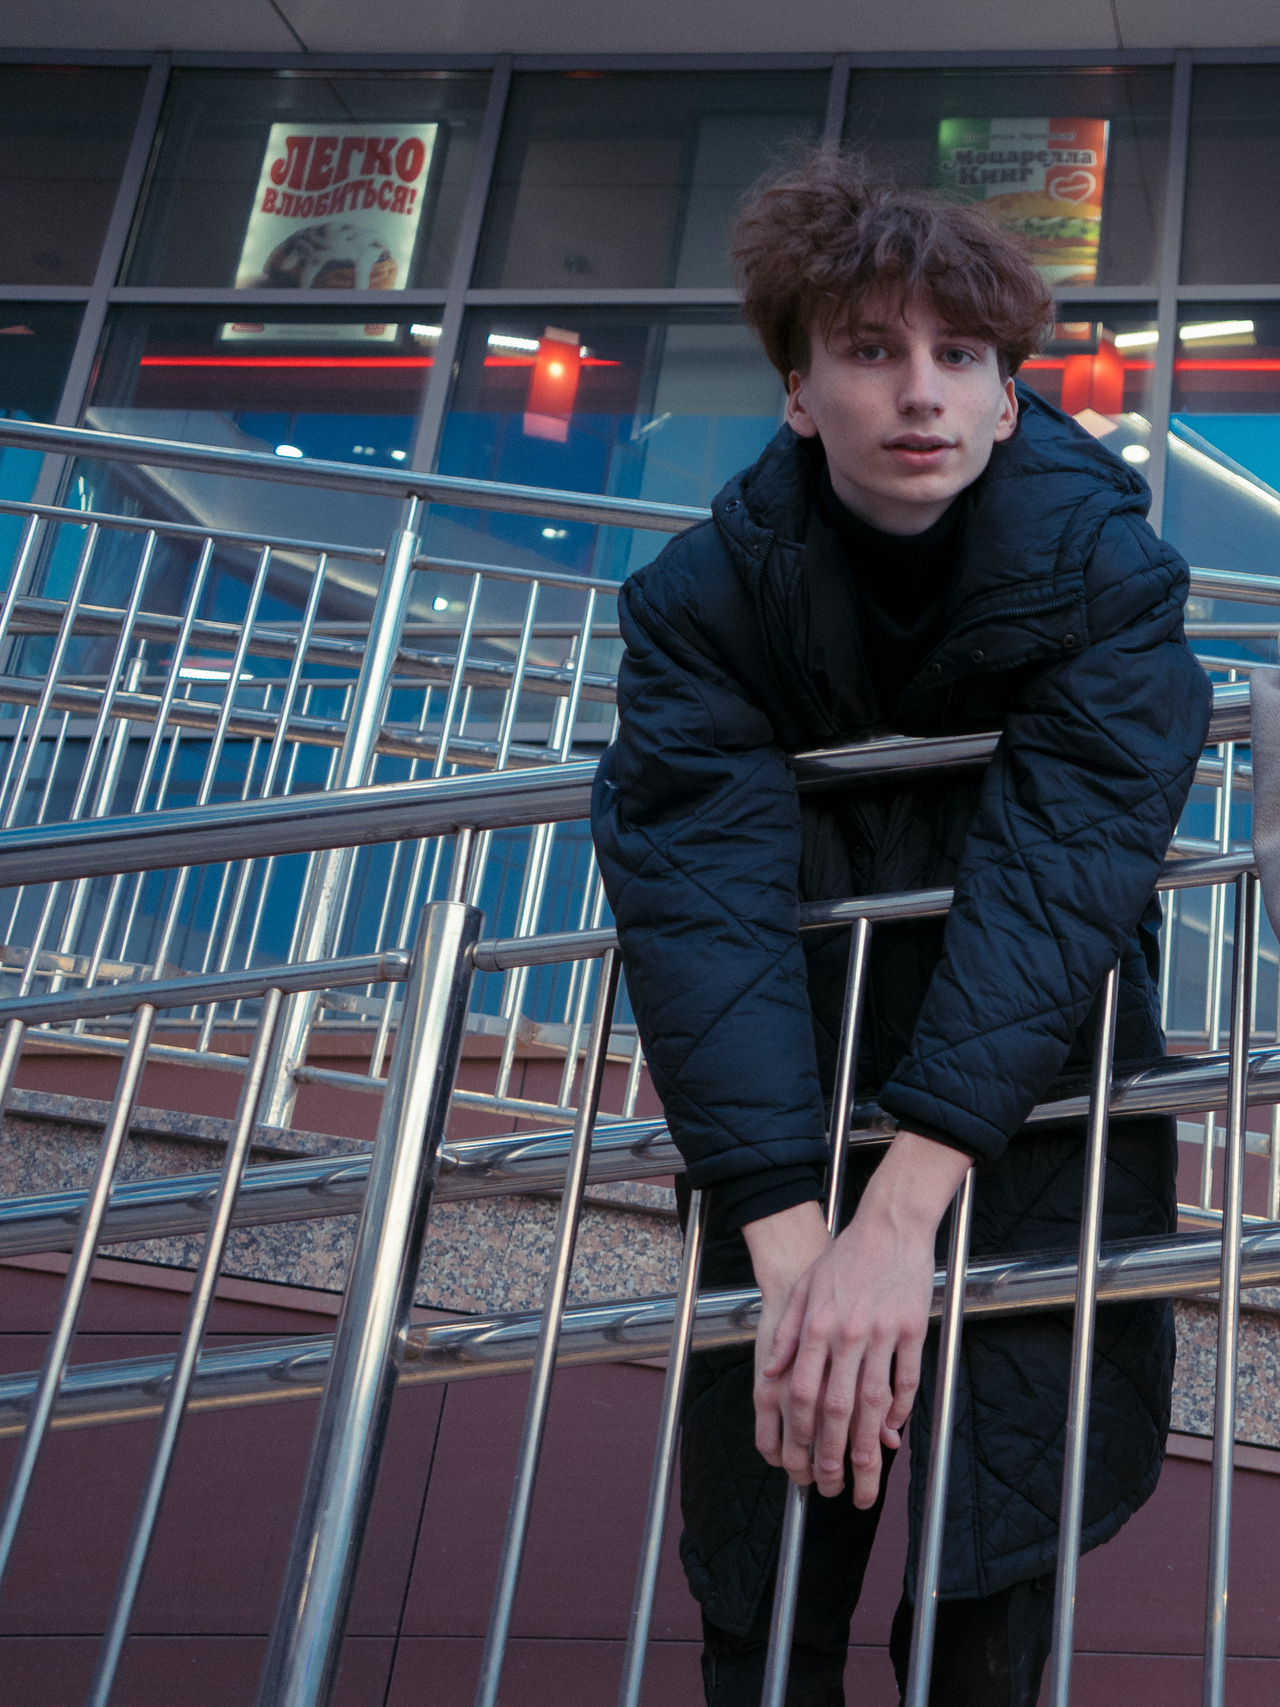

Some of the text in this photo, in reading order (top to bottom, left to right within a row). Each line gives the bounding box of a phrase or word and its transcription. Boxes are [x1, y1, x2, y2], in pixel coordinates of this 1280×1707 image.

[269, 135, 425, 192] ЛЕГКО
[945, 150, 1093, 168] Моцарелла
[958, 167, 1033, 185] Кинг
[260, 178, 418, 218] ВЛЮБИТЬСЯ!
